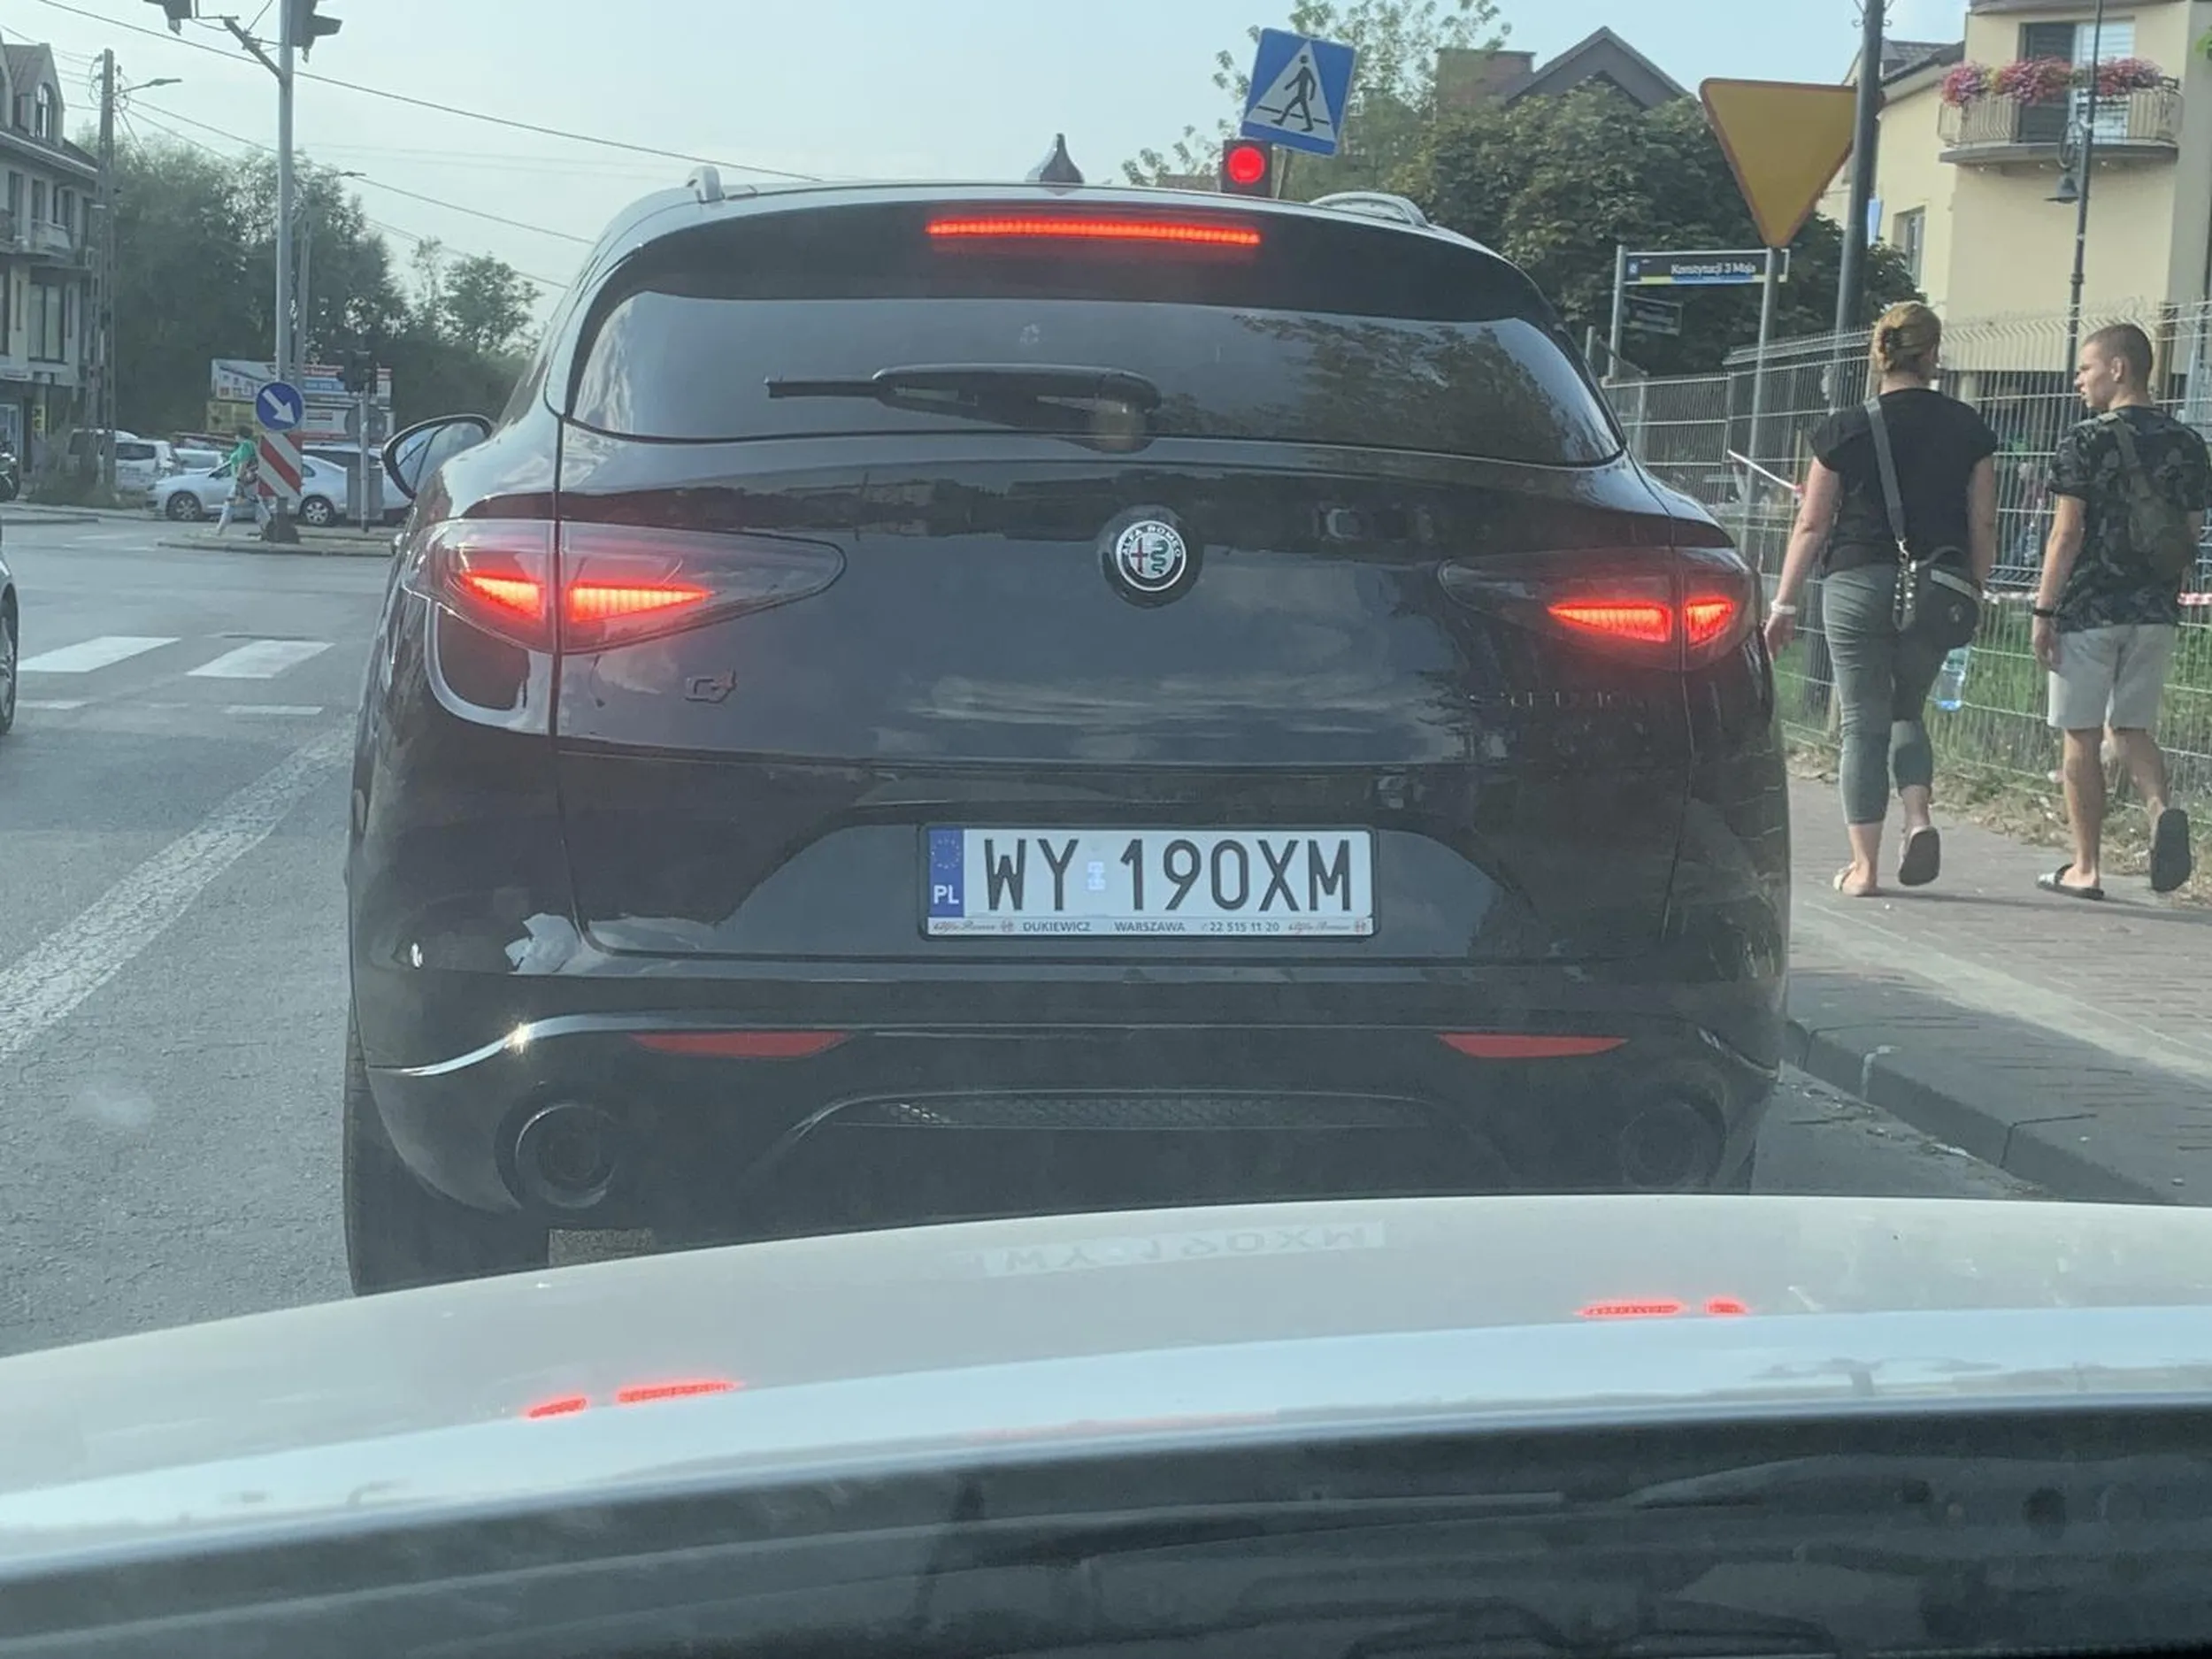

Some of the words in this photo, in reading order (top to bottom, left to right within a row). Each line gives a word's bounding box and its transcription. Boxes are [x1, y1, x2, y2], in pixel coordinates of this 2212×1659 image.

[1147, 525, 1181, 557] ROMEO
[984, 838, 1079, 911] WY
[1119, 838, 1351, 911] 190XM
[933, 885, 959, 904] PL
[1023, 921, 1091, 933] DUKIEWICZ
[1115, 921, 1186, 932] WARSZAWA
[1210, 922, 1224, 932] 22
[1226, 922, 1248, 932] 515
[1265, 922, 1280, 932] 20
